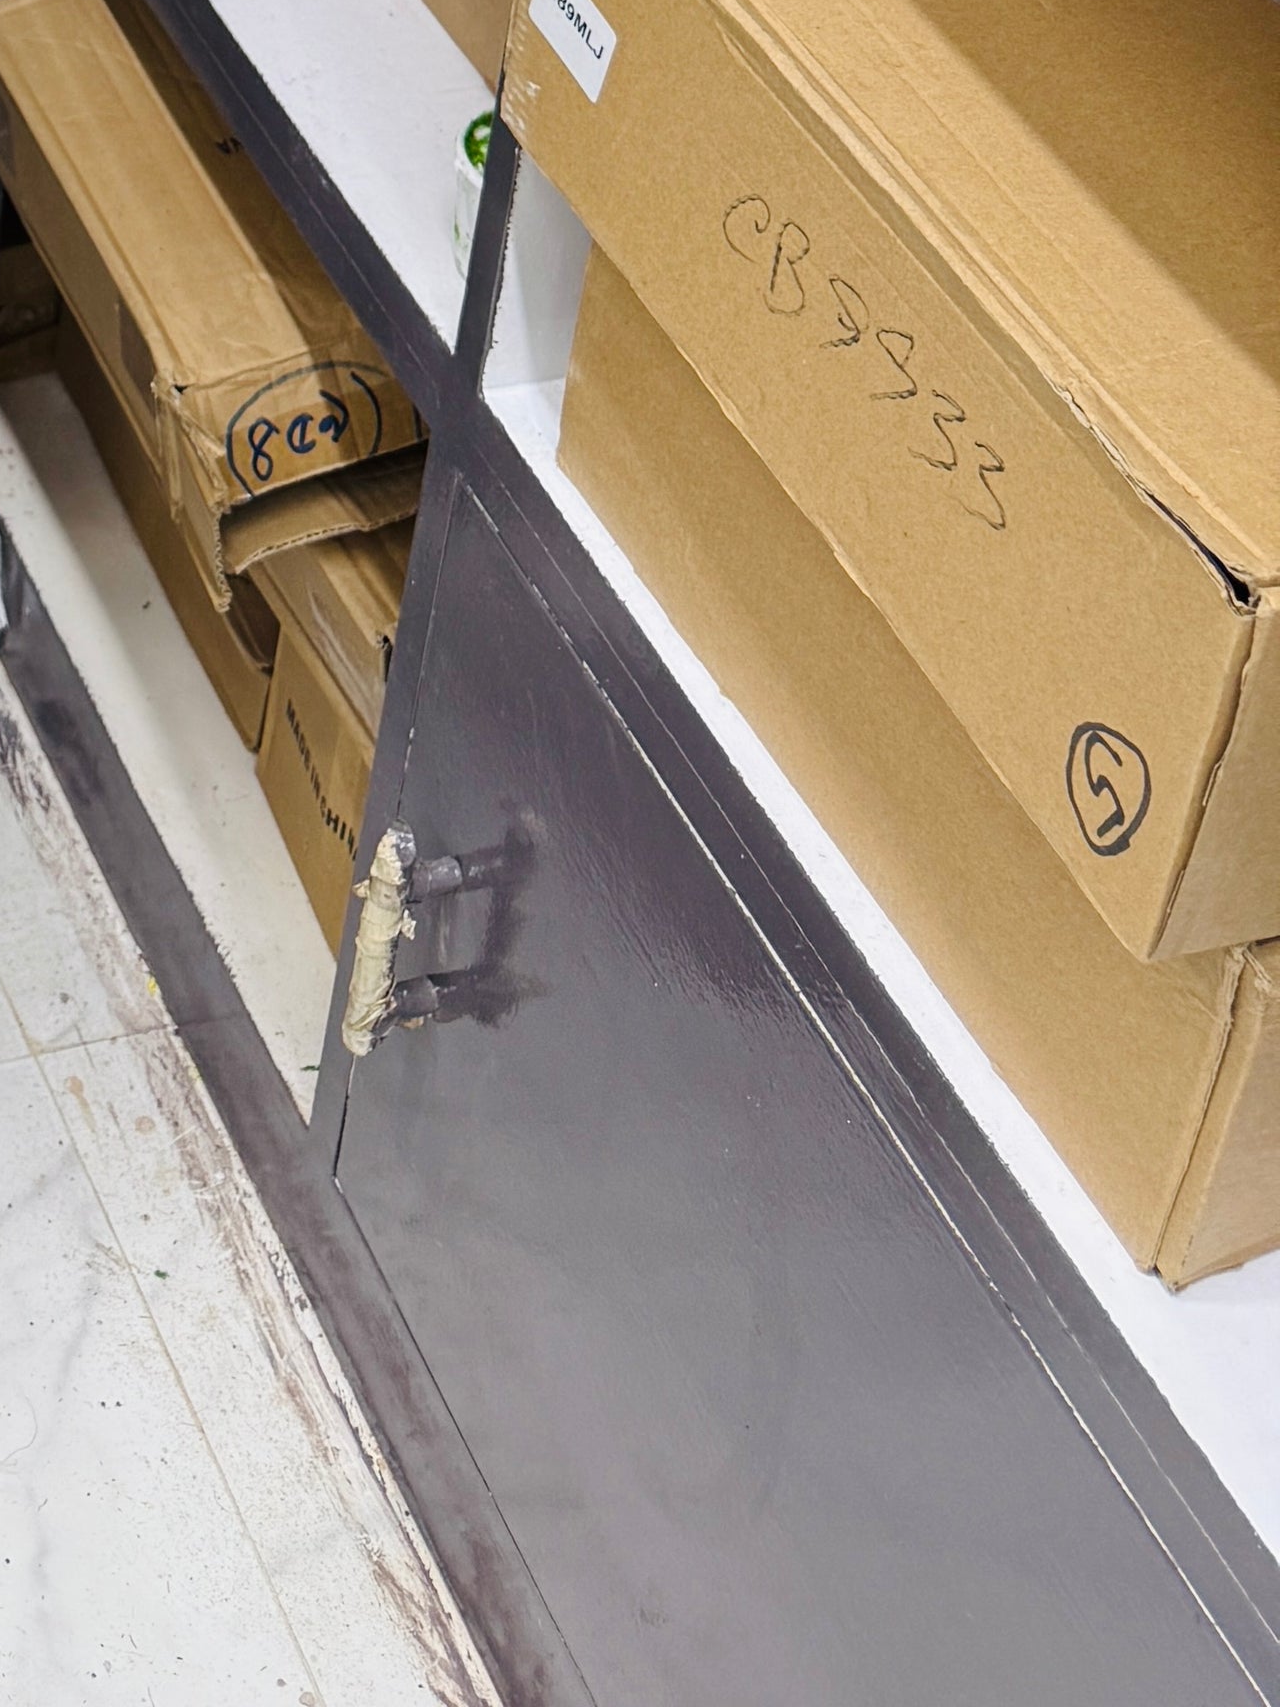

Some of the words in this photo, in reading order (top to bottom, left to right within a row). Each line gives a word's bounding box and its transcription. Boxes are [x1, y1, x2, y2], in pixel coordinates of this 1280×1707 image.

[286, 698, 311, 772] MADE
[310, 764, 321, 801] IN
[320, 794, 358, 862] CHIN
